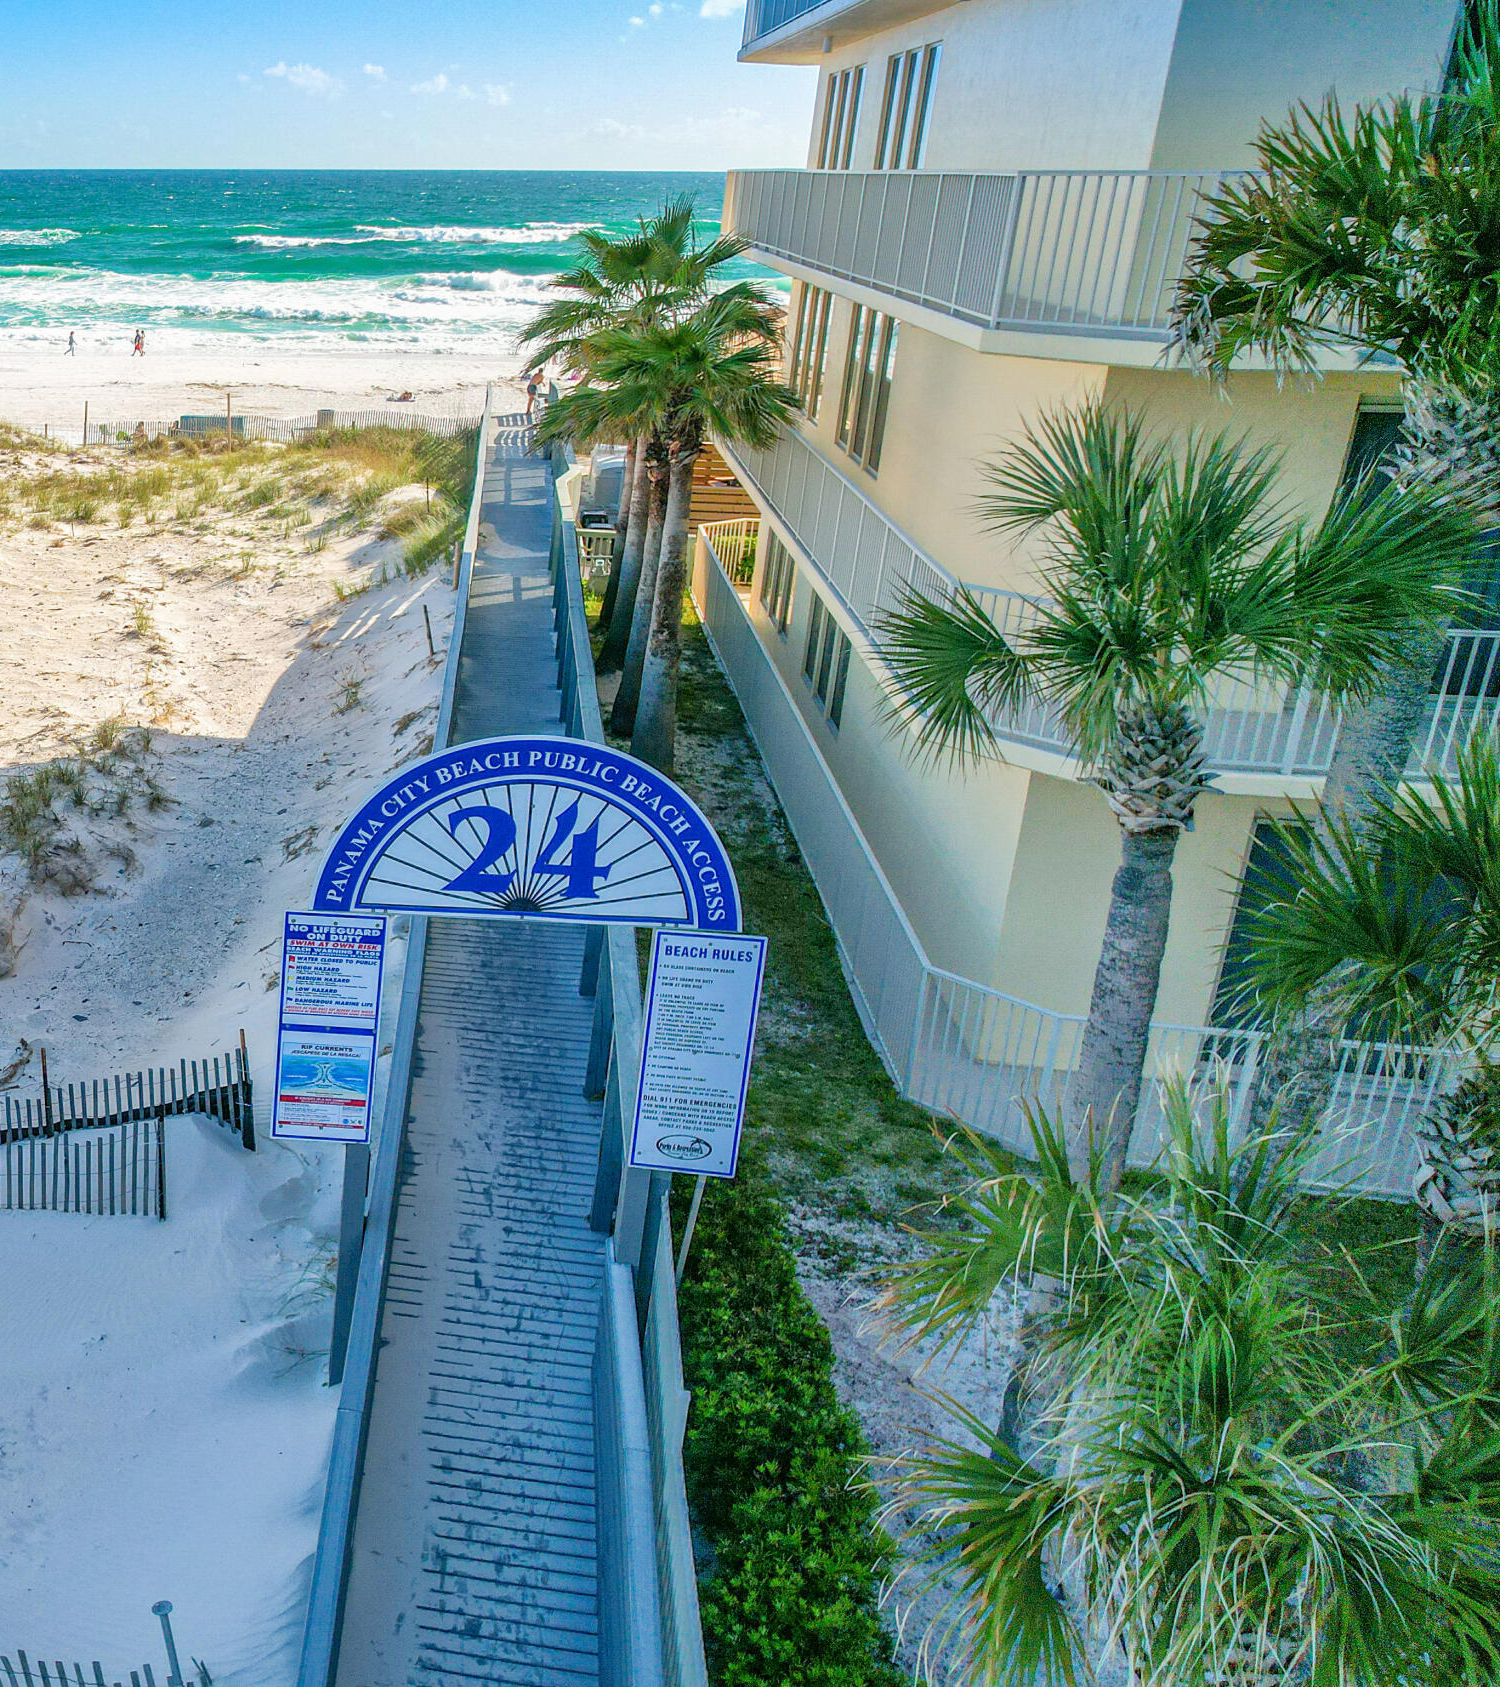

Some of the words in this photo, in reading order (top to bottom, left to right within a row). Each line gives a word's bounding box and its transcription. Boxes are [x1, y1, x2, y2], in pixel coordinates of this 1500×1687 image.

[326, 816, 384, 903] PANAMA
[382, 774, 430, 818] CITY
[435, 750, 520, 785] BEACH
[529, 750, 619, 782] PUBLIC
[619, 774, 692, 837] BEACH
[682, 836, 726, 922] ACCESS
[441, 797, 612, 899] 24
[313, 926, 380, 936] LIFEGUARD
[330, 934, 362, 942] DUTY
[665, 945, 707, 958] BEACH
[712, 949, 753, 962] RULES
[690, 1099, 737, 1109] EMERGENCIES
